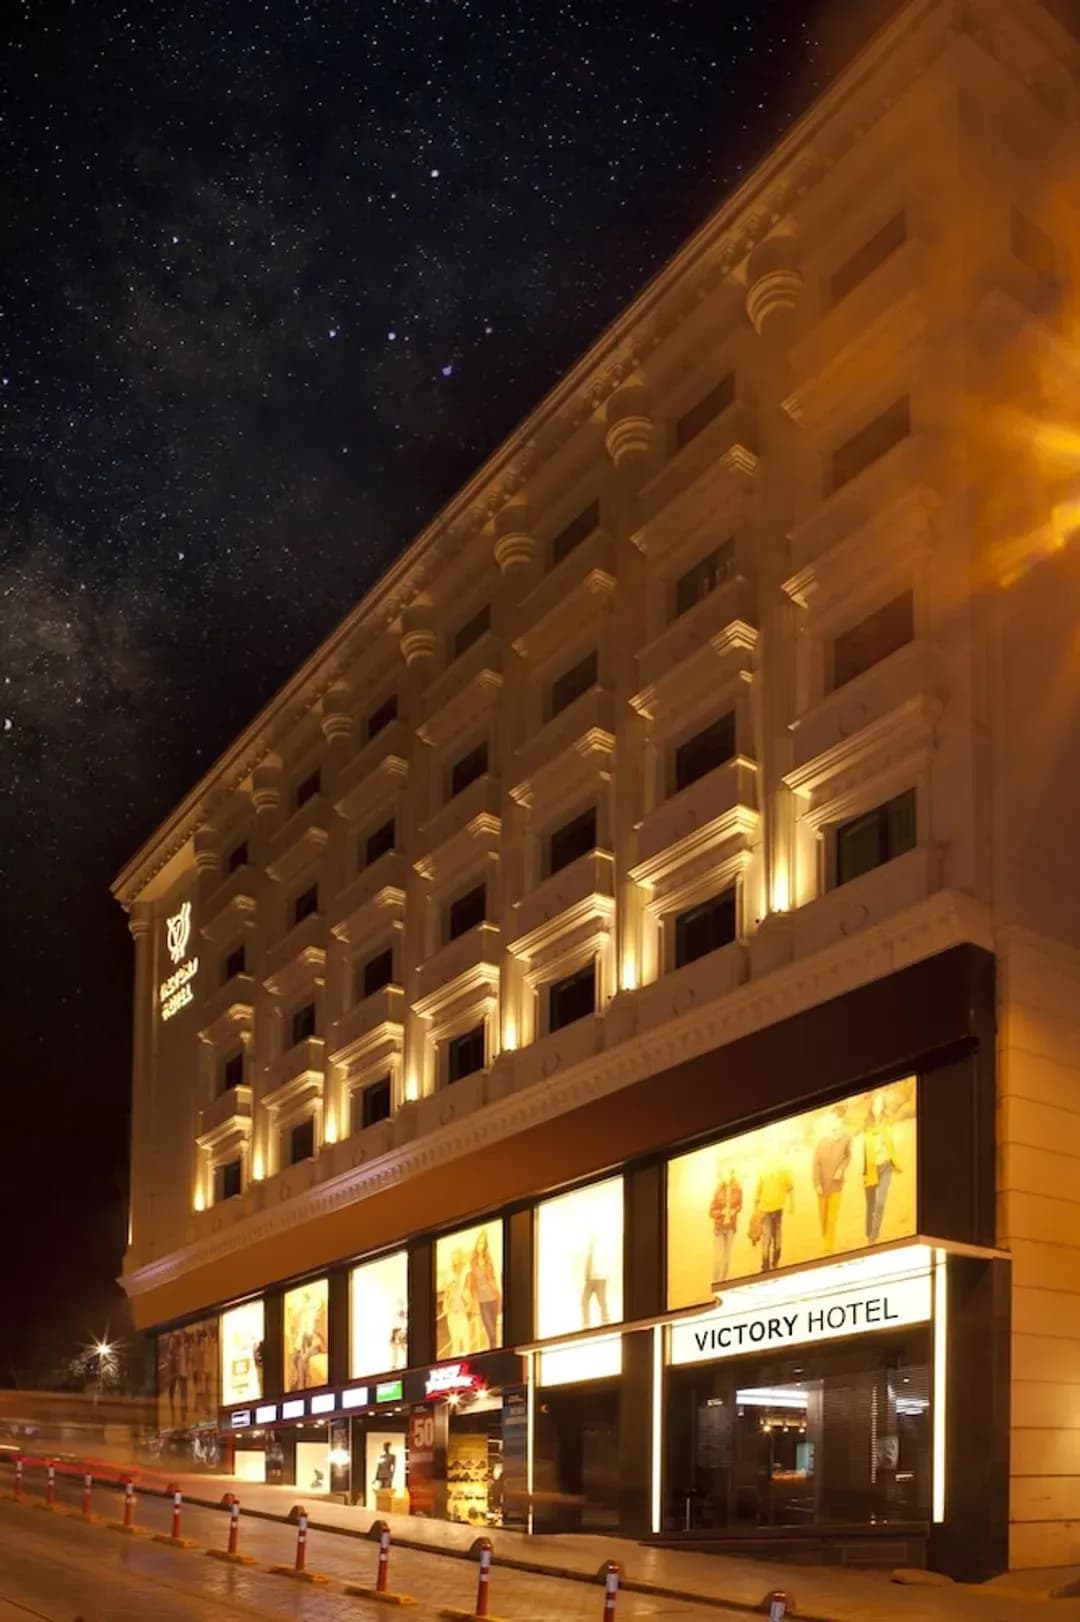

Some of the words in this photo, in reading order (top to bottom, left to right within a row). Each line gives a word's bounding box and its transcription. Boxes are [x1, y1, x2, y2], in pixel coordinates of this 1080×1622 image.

[694, 1314, 798, 1351] VICTORY
[808, 1298, 898, 1333] HOTEL
[414, 1418, 433, 1447] 50
